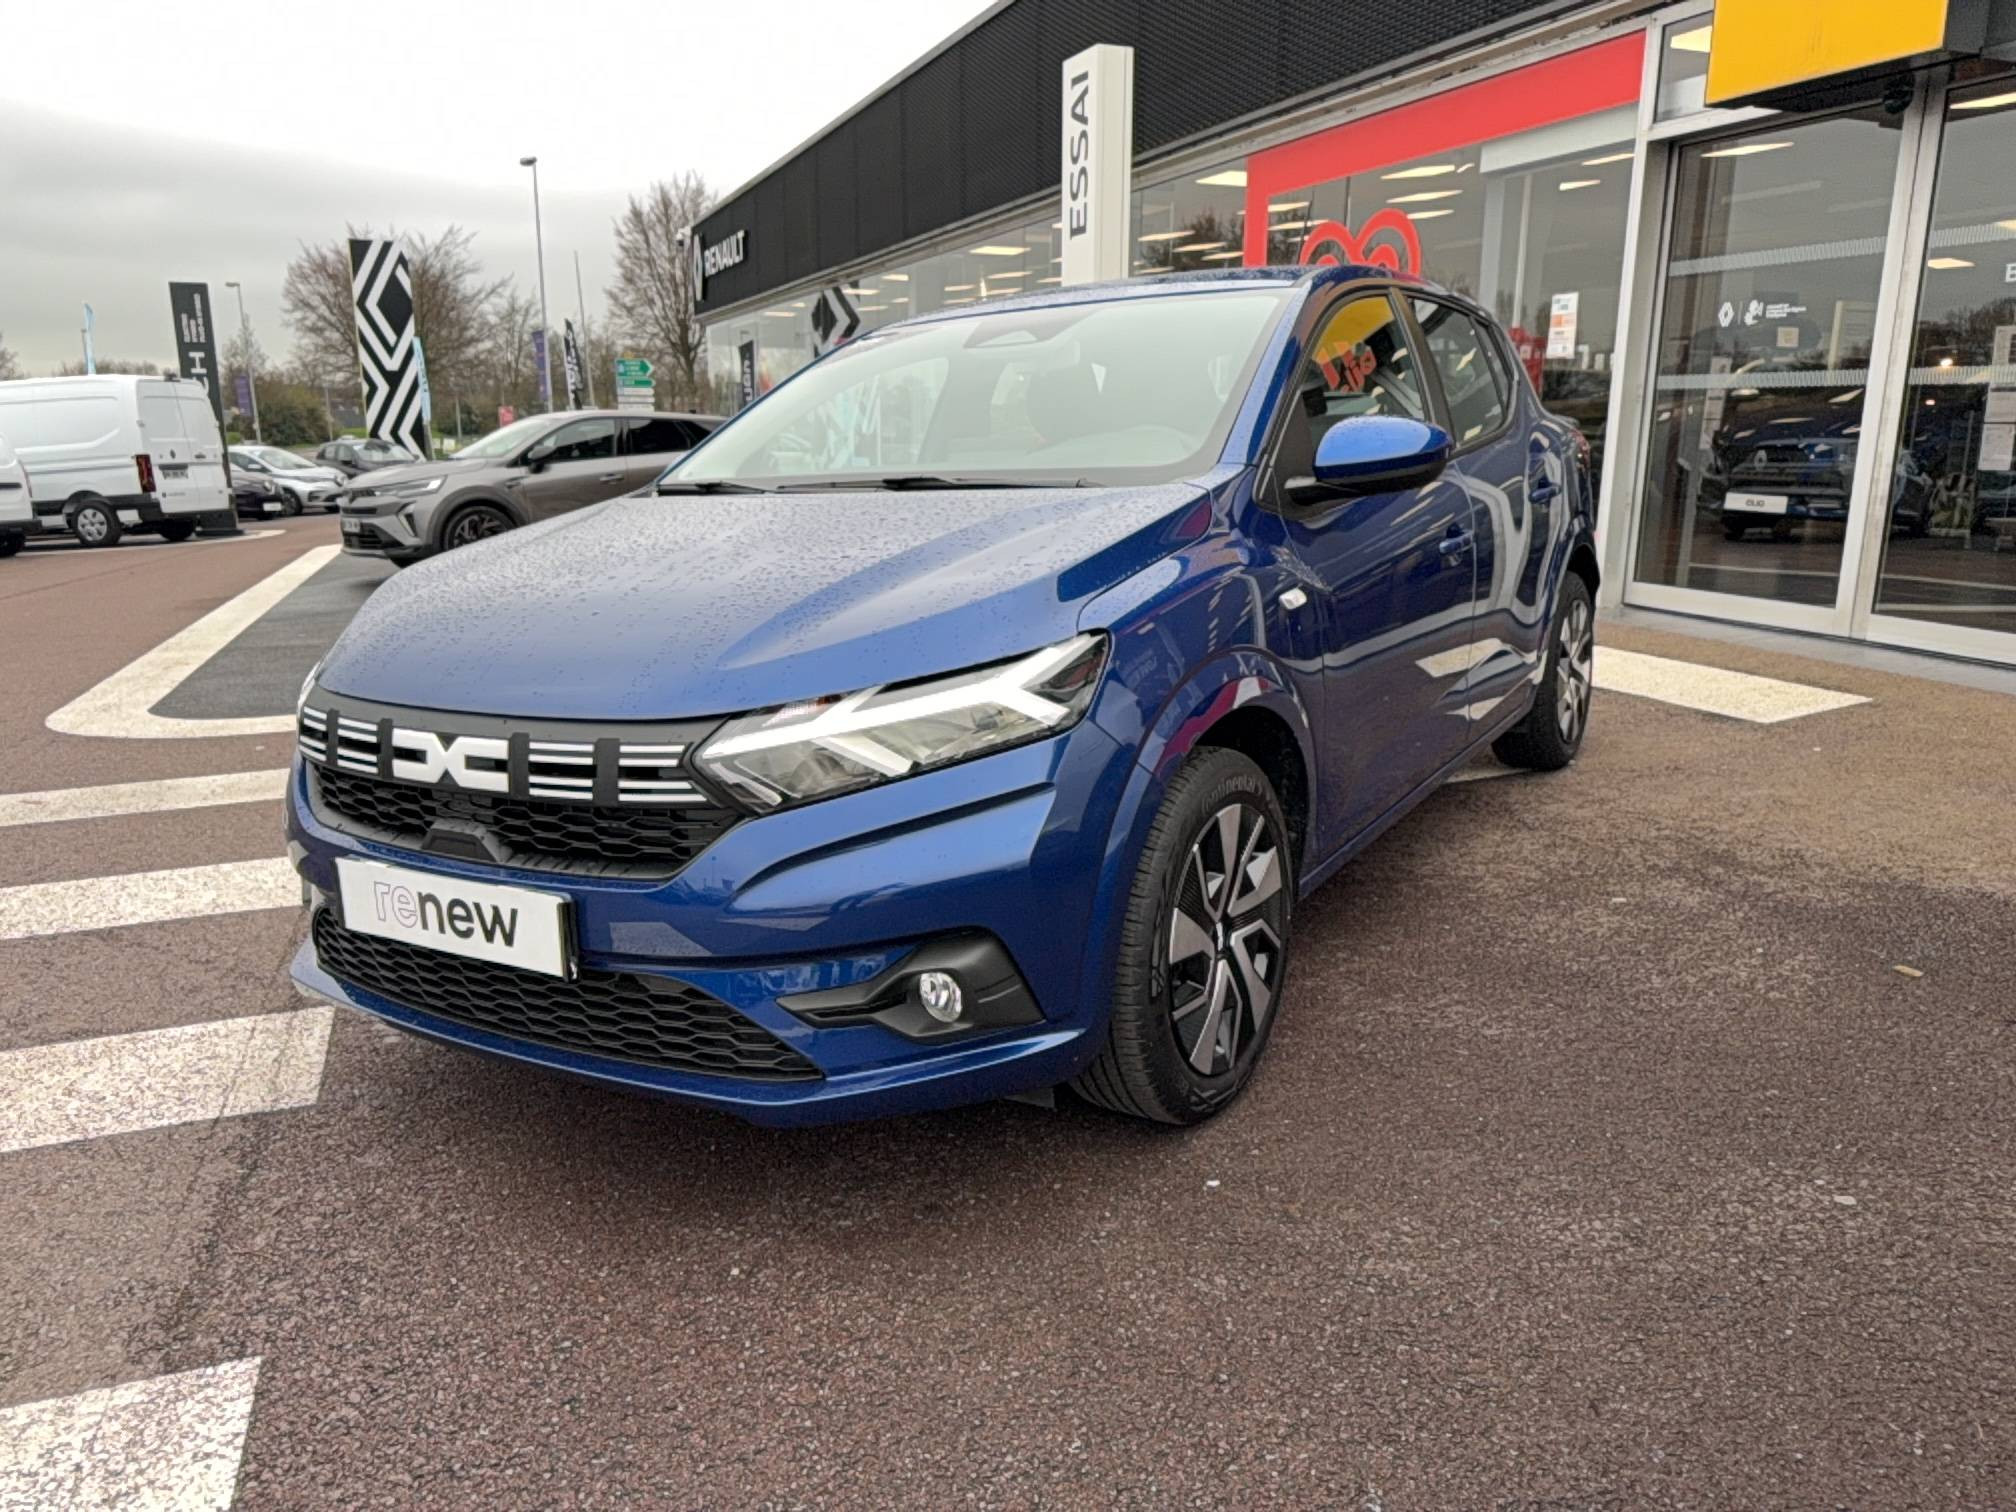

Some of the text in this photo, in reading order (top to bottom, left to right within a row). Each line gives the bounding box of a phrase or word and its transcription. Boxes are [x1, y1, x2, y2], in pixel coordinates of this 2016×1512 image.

[1070, 70, 1089, 240] ESSAI
[704, 229, 745, 278] RENAULT
[373, 881, 518, 948] renew
